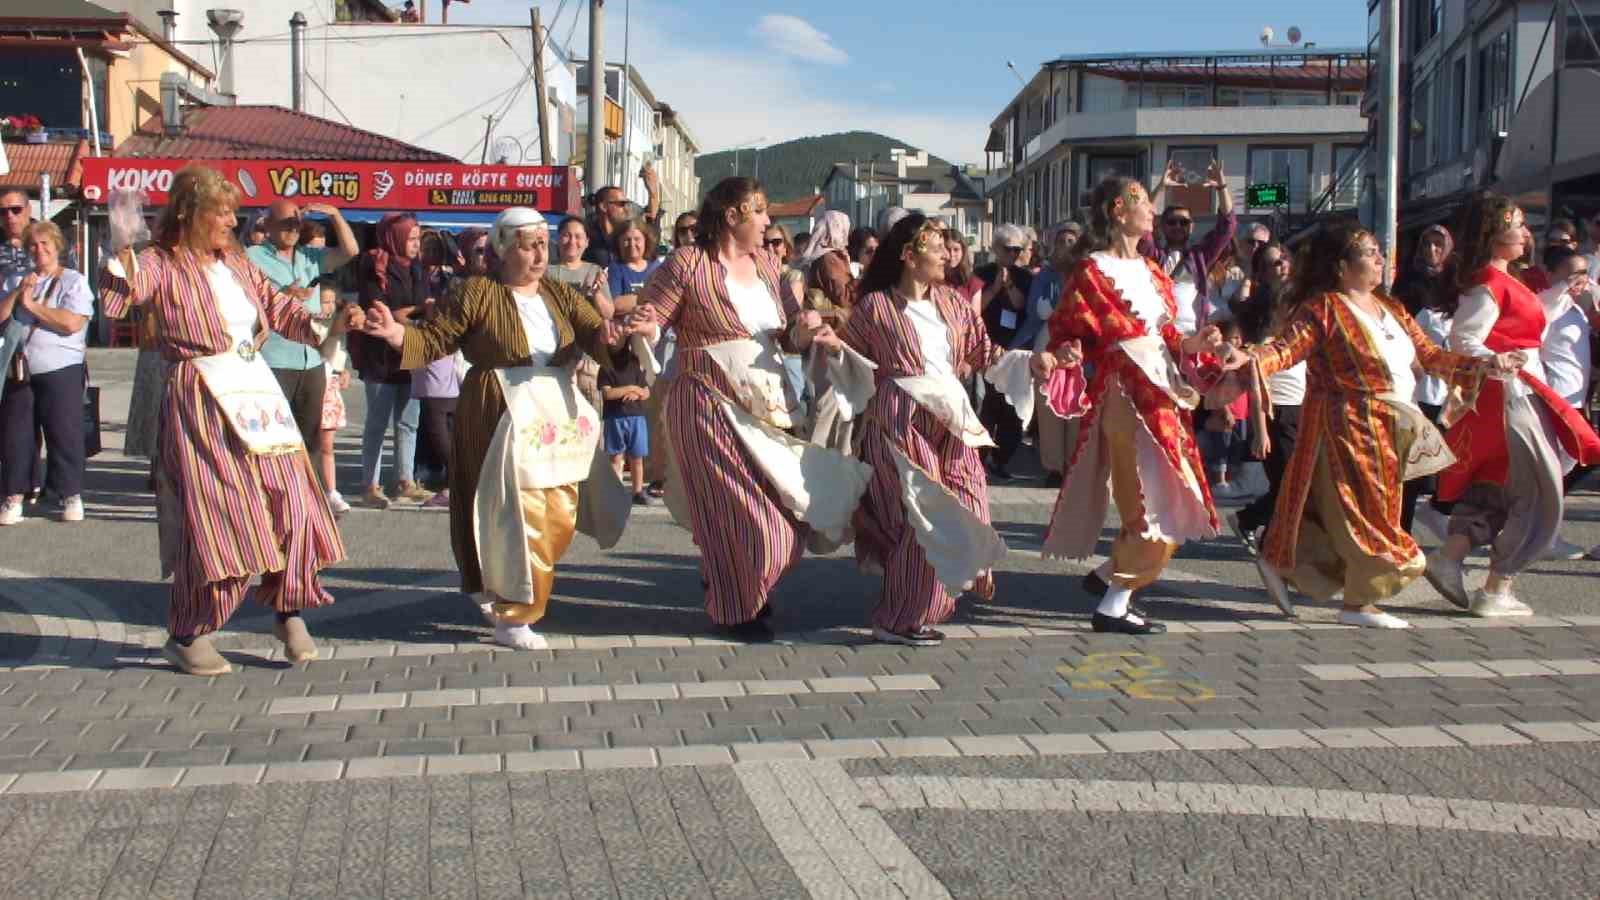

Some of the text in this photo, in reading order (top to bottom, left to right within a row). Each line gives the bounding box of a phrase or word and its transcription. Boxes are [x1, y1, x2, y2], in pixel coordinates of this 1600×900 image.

[404, 168, 563, 188] DÖNER KÖFTE SUCUK
